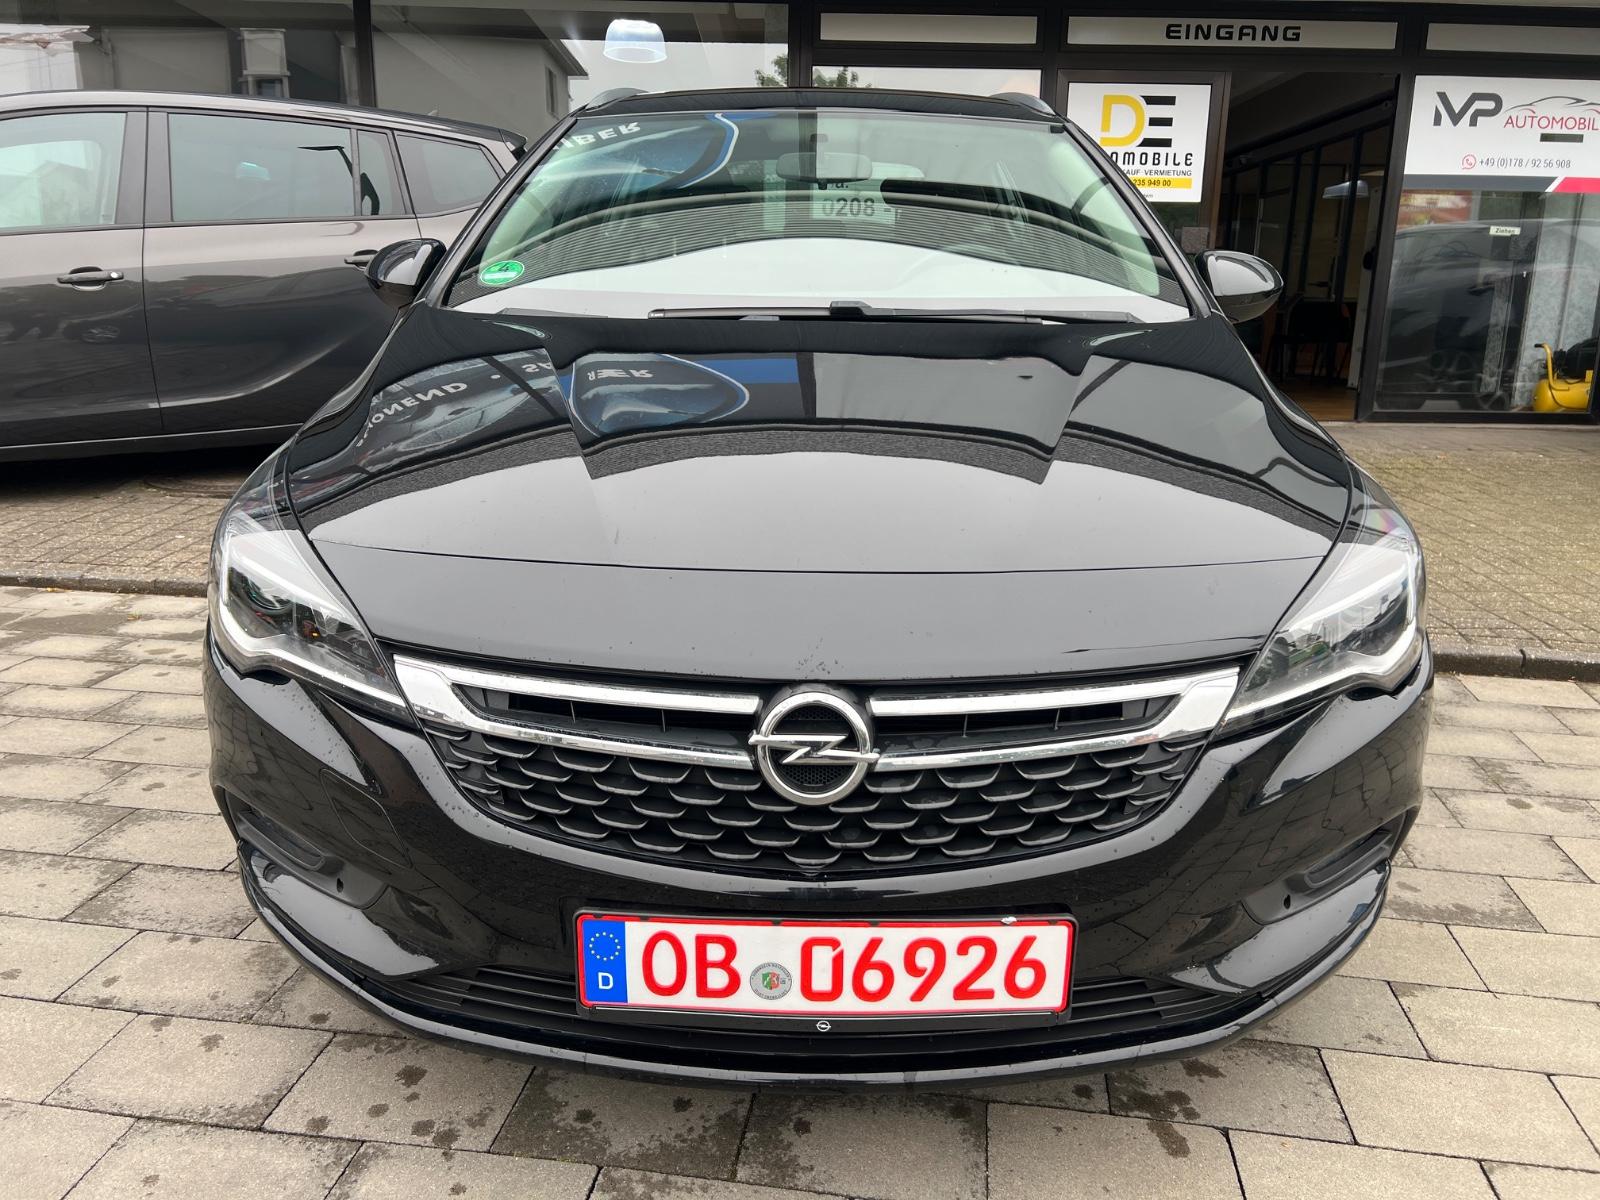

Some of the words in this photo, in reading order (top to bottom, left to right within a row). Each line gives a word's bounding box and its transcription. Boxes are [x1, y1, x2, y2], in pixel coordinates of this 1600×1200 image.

[1165, 23, 1302, 42] EINGANG
[1100, 94, 1177, 148] DE
[1122, 168, 1141, 176] AUF
[1144, 169, 1193, 177] VERMIETUNG
[1479, 157, 1495, 167] +49
[1531, 158, 1542, 168] 92
[1543, 159, 1554, 168] 56
[1555, 159, 1571, 169] 908
[822, 197, 875, 217] 0208
[641, 930, 741, 999] OB
[800, 934, 1047, 1002] 06926
[597, 971, 614, 990] D
